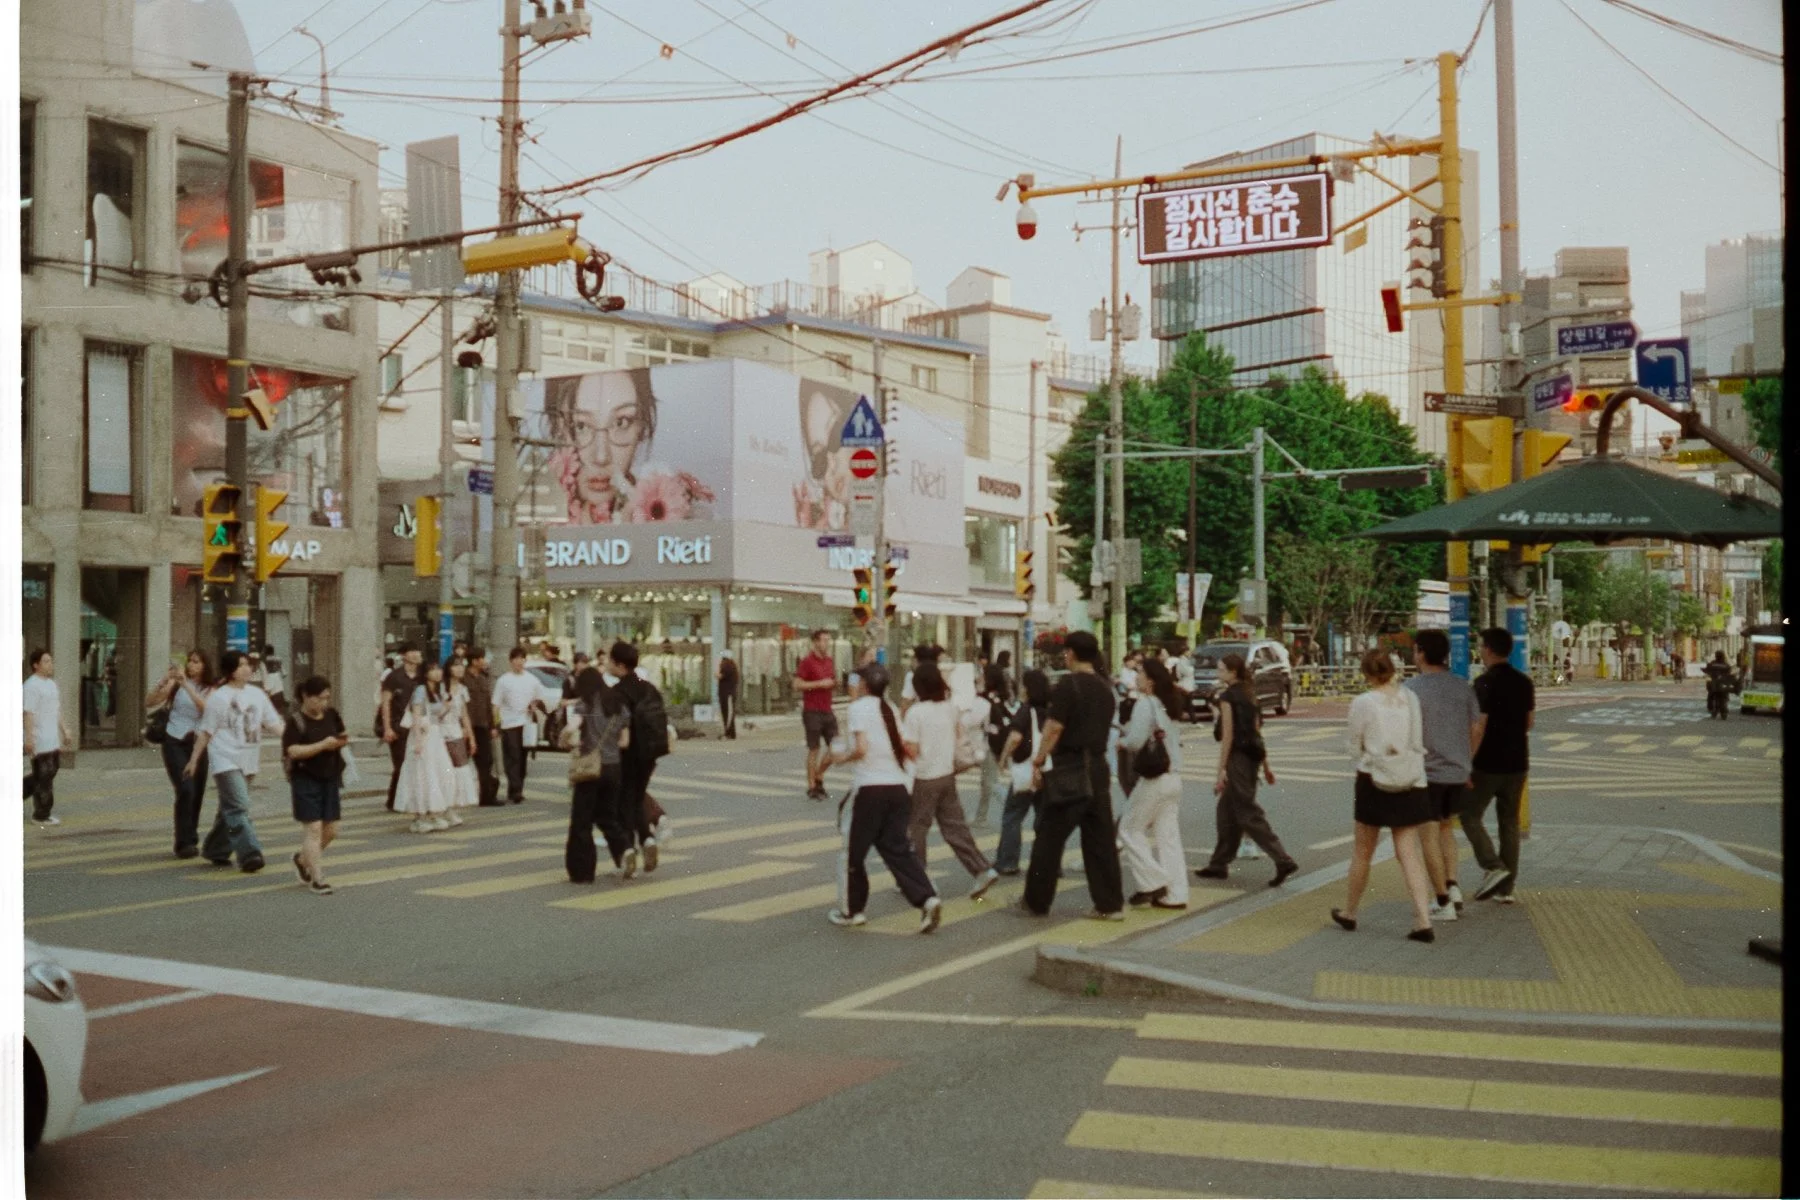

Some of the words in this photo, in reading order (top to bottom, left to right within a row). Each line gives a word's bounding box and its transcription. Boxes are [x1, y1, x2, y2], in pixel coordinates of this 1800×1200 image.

[1165, 189, 1240, 224] 정지선
[1247, 183, 1300, 216] 준수
[1165, 211, 1300, 252] 감사합니다
[657, 534, 712, 564] Rieti
